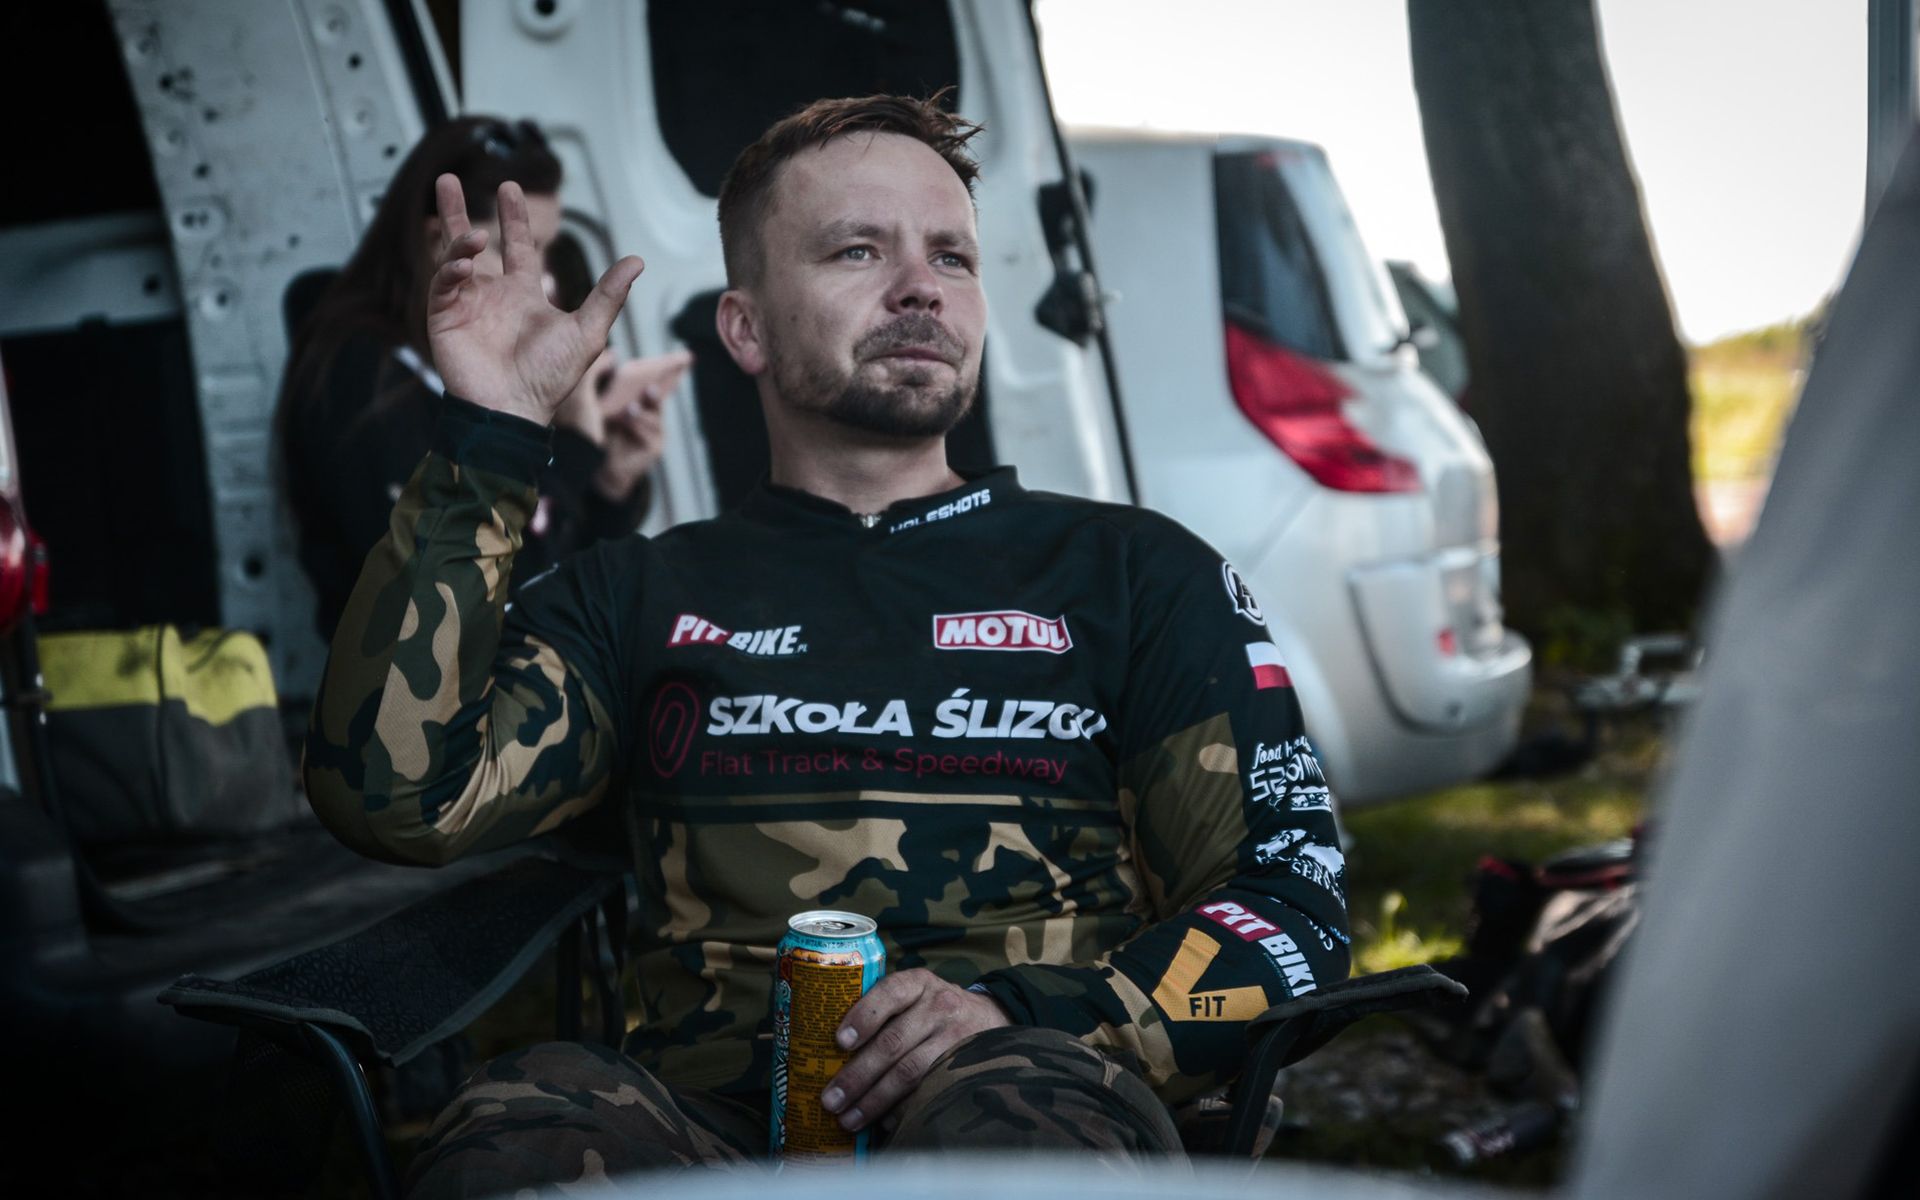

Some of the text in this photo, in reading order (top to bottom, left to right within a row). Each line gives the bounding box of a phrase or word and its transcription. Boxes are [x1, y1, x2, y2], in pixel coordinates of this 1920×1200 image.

[939, 616, 1066, 649] MOTUL
[706, 695, 914, 737] SZKOŁA
[701, 747, 1068, 784] Flat Track & Speedway
[1252, 742, 1282, 770] food
[1203, 902, 1277, 935] PIT
[1189, 995, 1227, 1018] FIT
